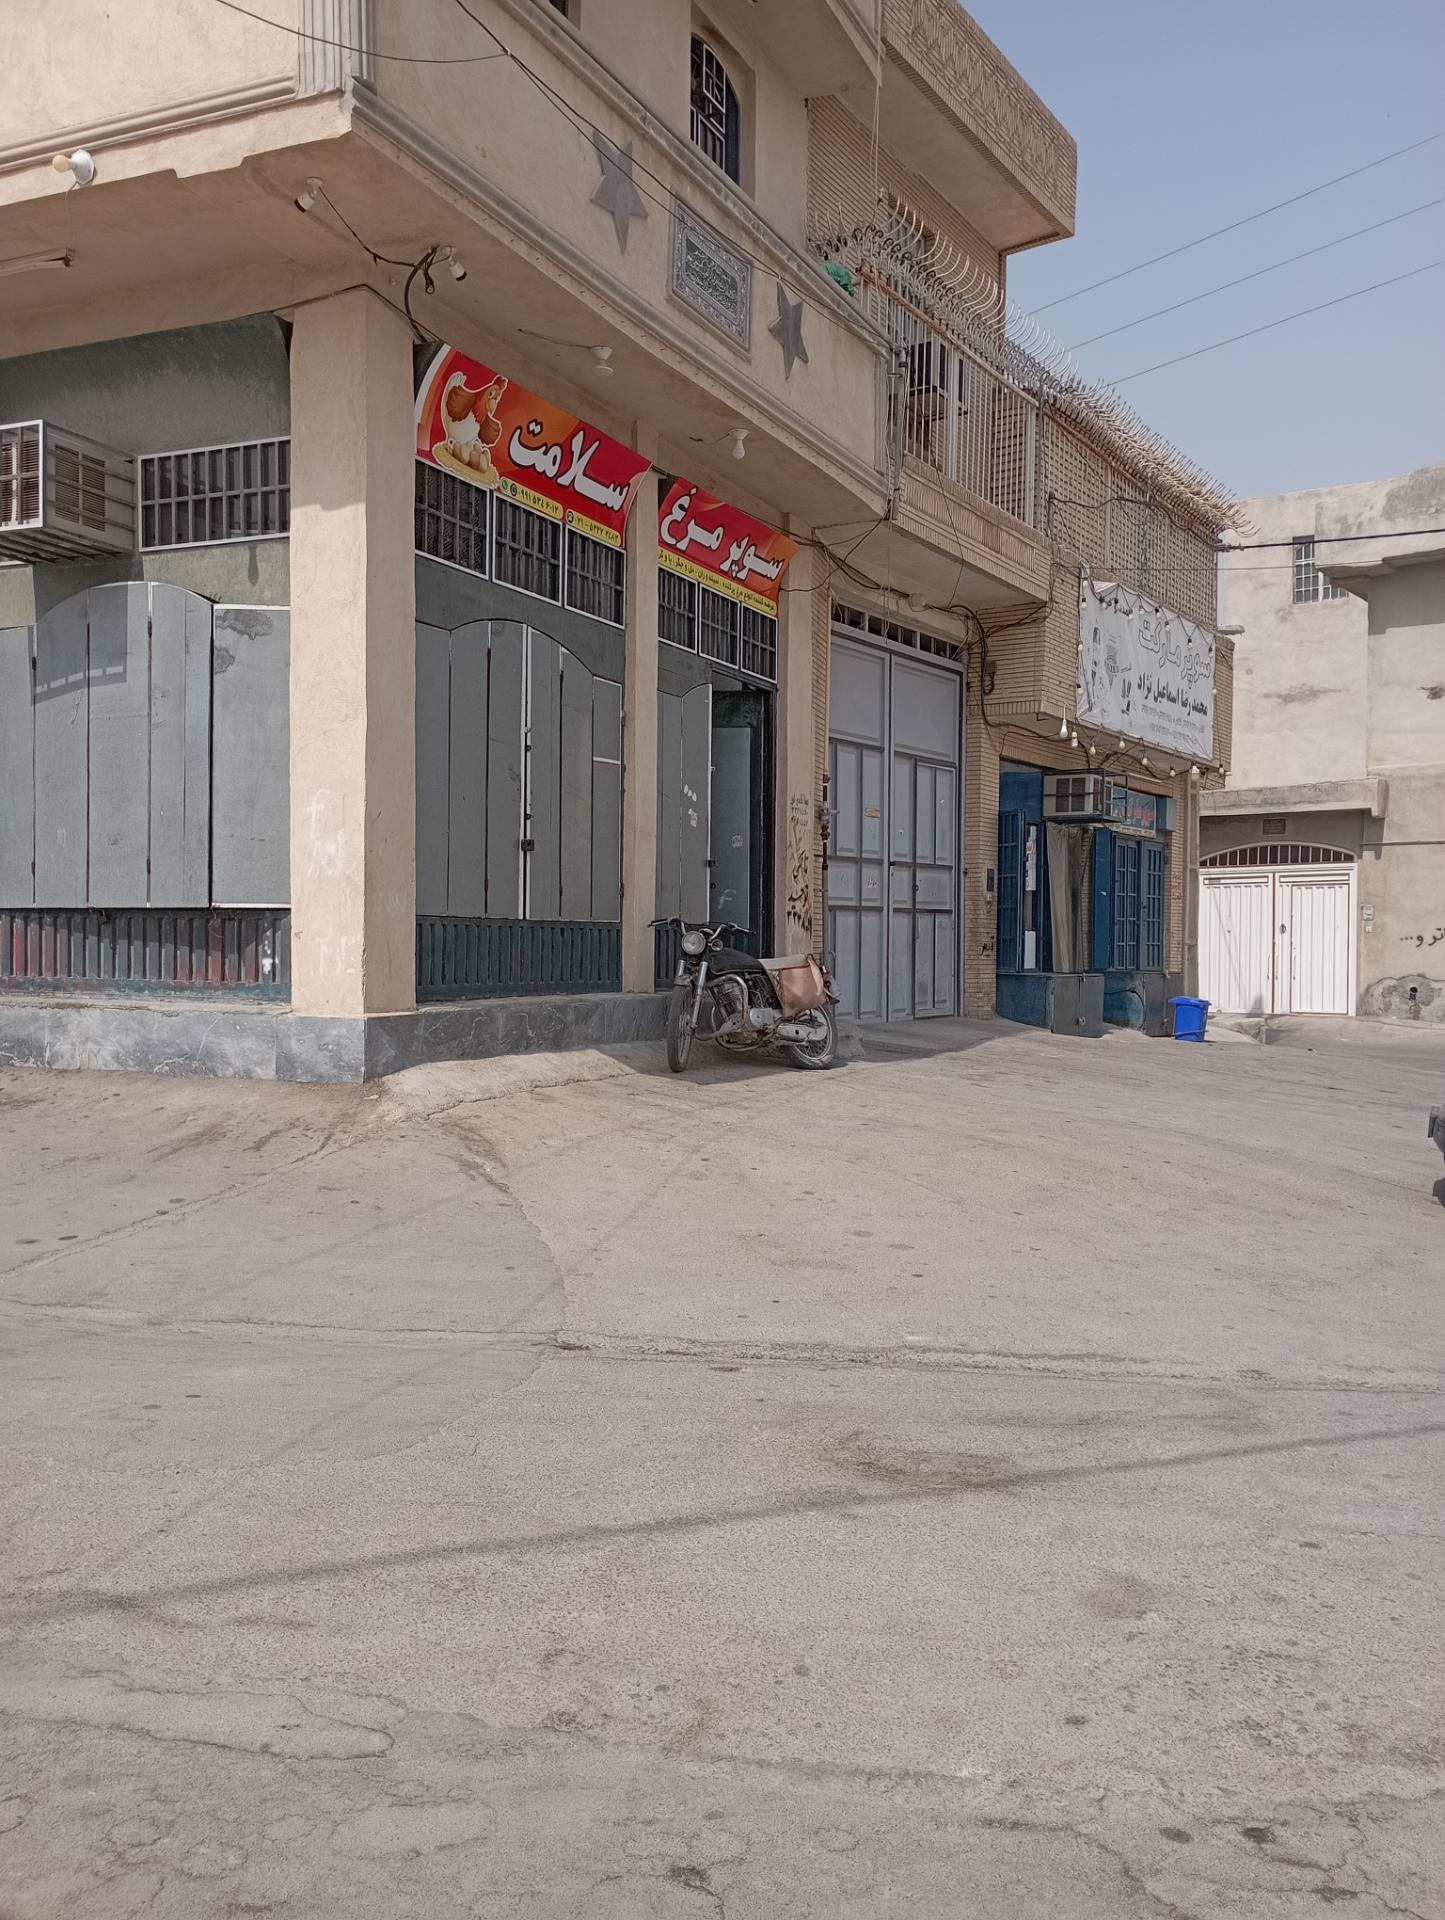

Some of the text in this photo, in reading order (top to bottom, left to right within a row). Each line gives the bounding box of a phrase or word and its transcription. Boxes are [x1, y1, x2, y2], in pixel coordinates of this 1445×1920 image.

[508, 420, 630, 512] سلامت
[659, 487, 784, 580] سوپر مرغ
[1138, 619, 1181, 668] مارکت
[1137, 671, 1153, 700] نژاد
[1153, 677, 1181, 706] اسماعیل
[1181, 653, 1211, 690] سوپر
